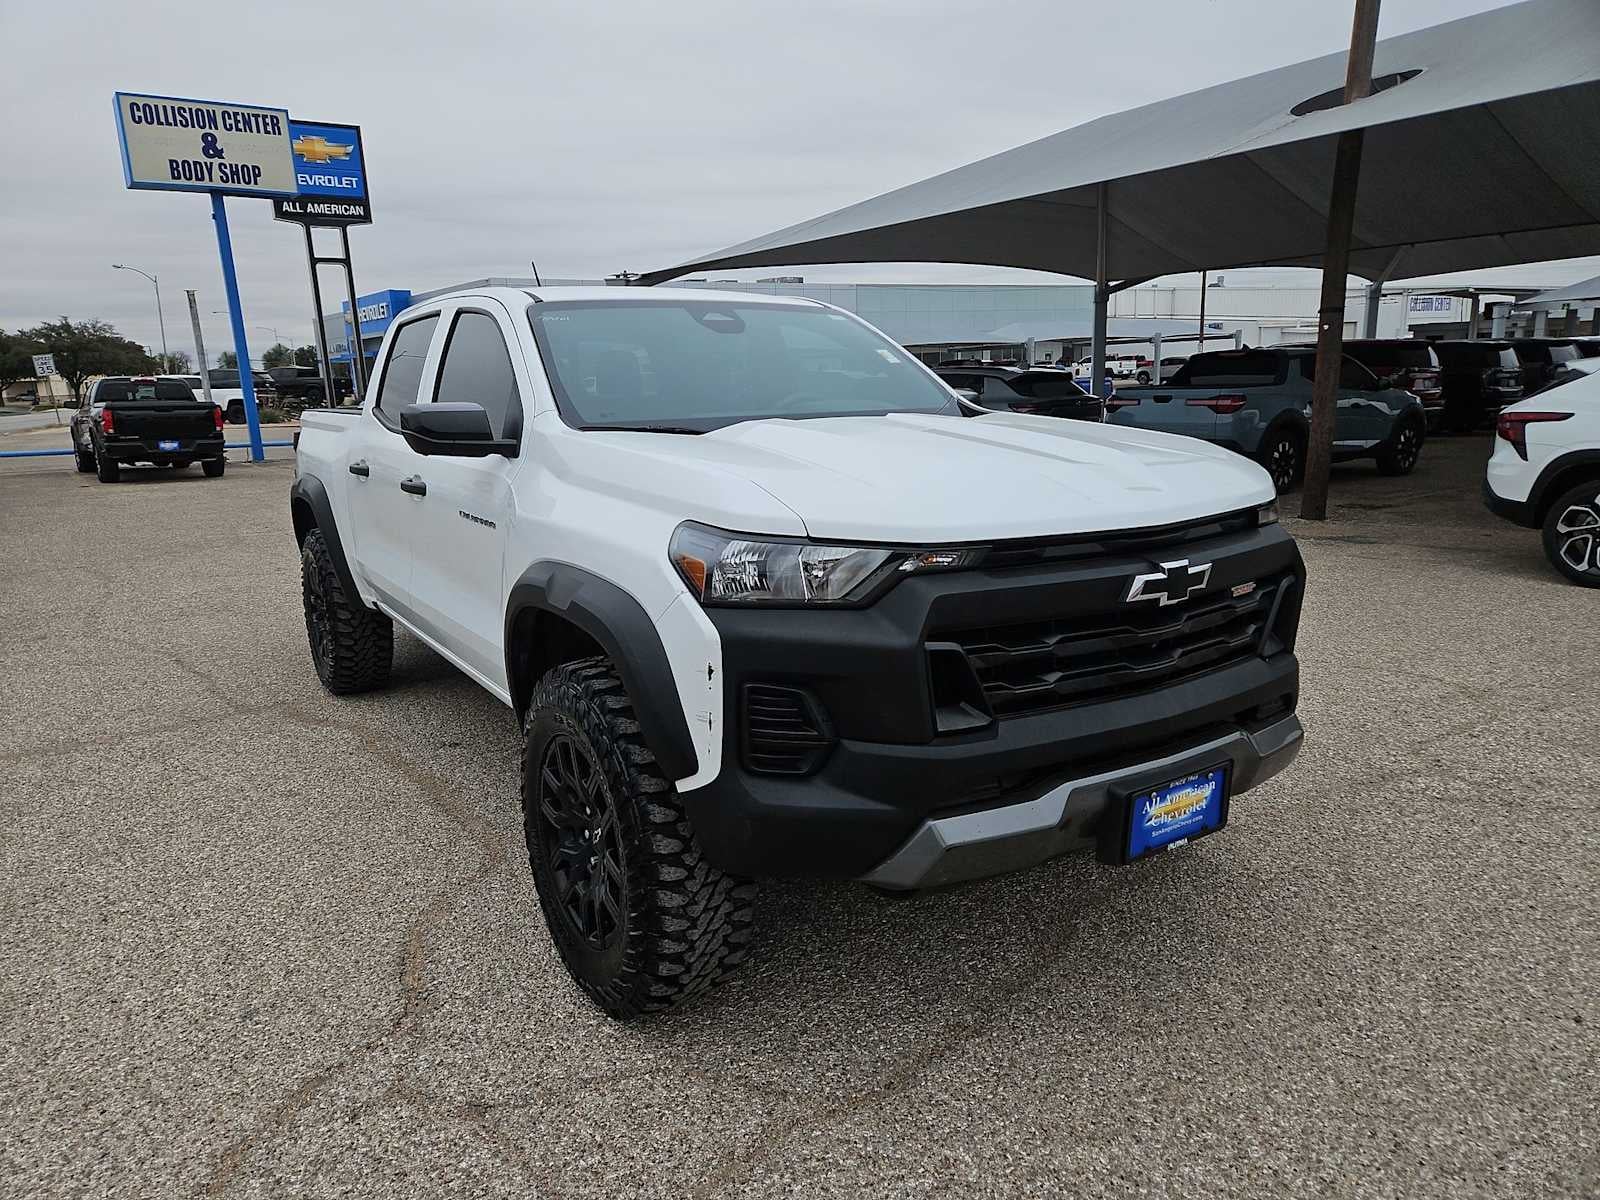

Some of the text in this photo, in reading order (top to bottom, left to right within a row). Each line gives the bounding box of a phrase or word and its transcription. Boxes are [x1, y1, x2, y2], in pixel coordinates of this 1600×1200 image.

[129, 102, 282, 136] COLLISION CENTER
[201, 132, 225, 159] &
[168, 159, 262, 186] BODY SHOP
[297, 173, 359, 189] EVROLET
[282, 201, 365, 216] ALL AMERICAN
[358, 302, 388, 323] HEVROLET
[38, 366, 54, 375] 35
[1142, 780, 1216, 814] All American
[1152, 797, 1208, 826] Chevrolet
